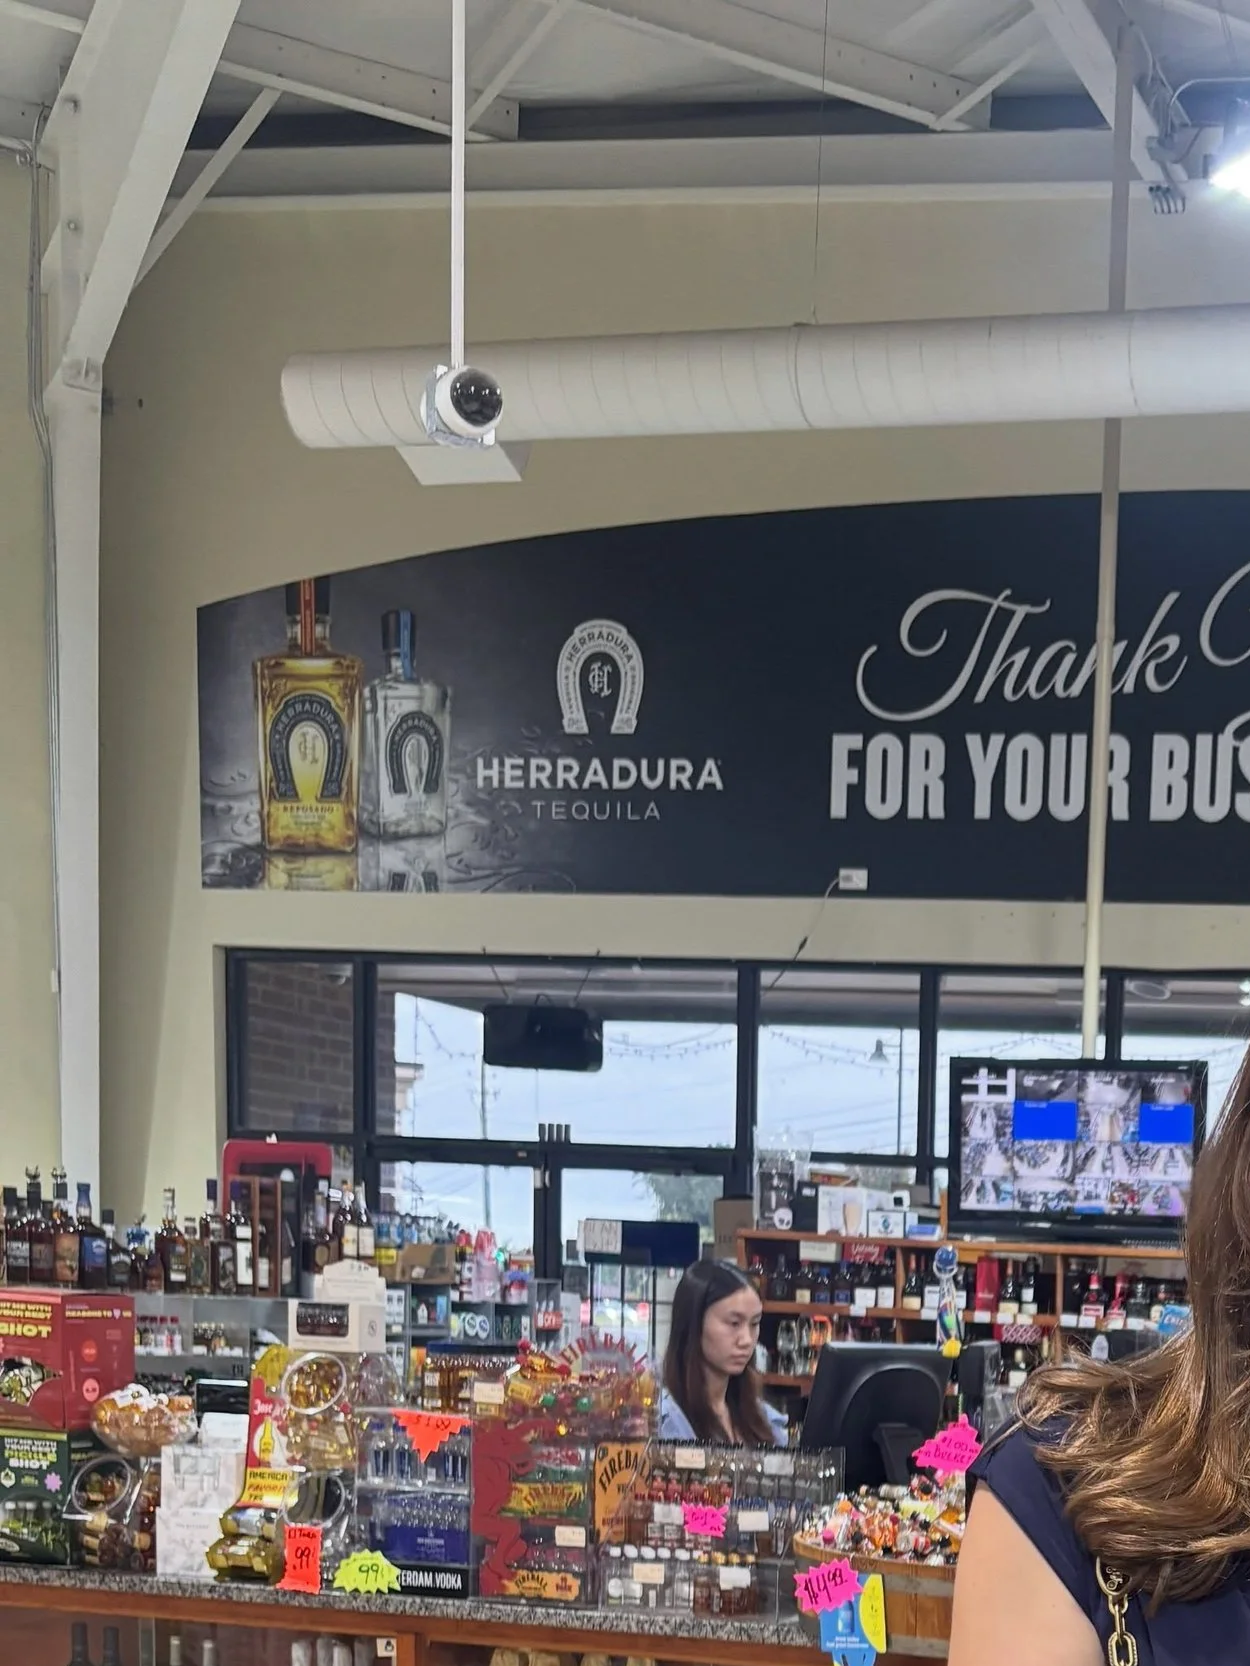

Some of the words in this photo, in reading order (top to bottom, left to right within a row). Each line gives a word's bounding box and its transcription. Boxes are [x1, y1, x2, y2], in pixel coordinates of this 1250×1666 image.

[566, 630, 635, 665] HERRADURA
[857, 589, 1188, 722] Thank
[275, 701, 339, 734] HERRADURA
[475, 757, 723, 791] HERRADURA
[830, 732, 945, 820] FOR
[965, 732, 1131, 821] YOUR
[532, 801, 660, 821] TEQUILA
[434, 1571, 462, 1590] VODKA
